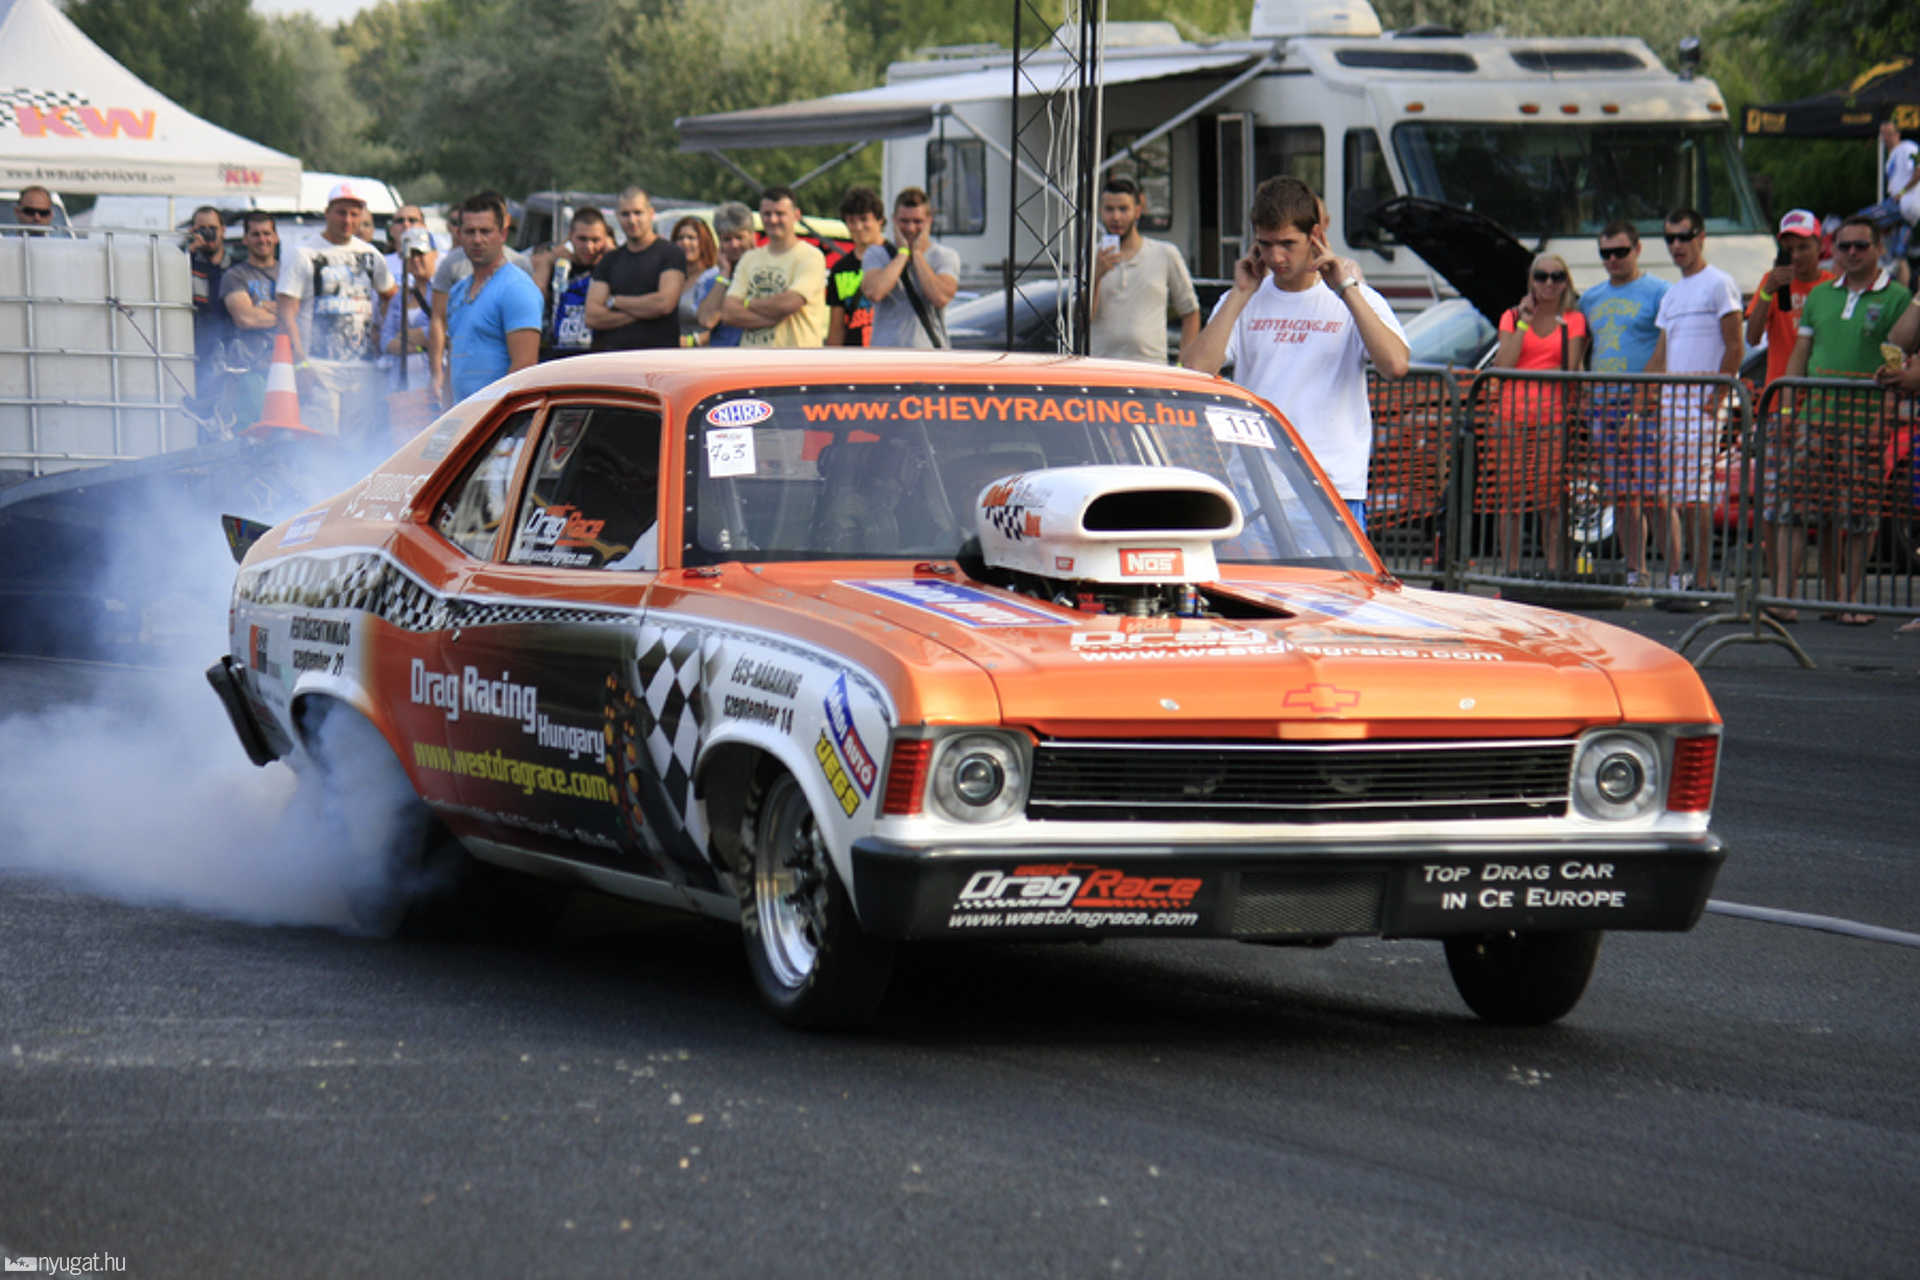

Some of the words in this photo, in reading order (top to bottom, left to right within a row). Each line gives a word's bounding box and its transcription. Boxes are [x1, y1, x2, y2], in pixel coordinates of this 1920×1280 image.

[13, 104, 156, 139] KW
[224, 168, 263, 186] KW
[1273, 332, 1308, 344] TEAM
[717, 404, 766, 422] NHRA
[802, 396, 1197, 427] www.CHEVYRACING.hu
[1225, 415, 1267, 438] 111
[1127, 553, 1174, 572] NOS
[411, 658, 460, 721] Drag
[463, 665, 537, 733] Racing
[538, 714, 606, 763] Hungary
[413, 741, 609, 802] www.westdragrace.com
[1423, 864, 1471, 883] TOP
[1481, 863, 1551, 881] DRAG
[1560, 861, 1615, 879] CAR
[958, 870, 1082, 907] Drag
[1076, 870, 1202, 900] Race
[1441, 892, 1467, 909] IN
[1525, 887, 1626, 908] EUROPE
[948, 909, 1198, 927] www.westdragrace.com
